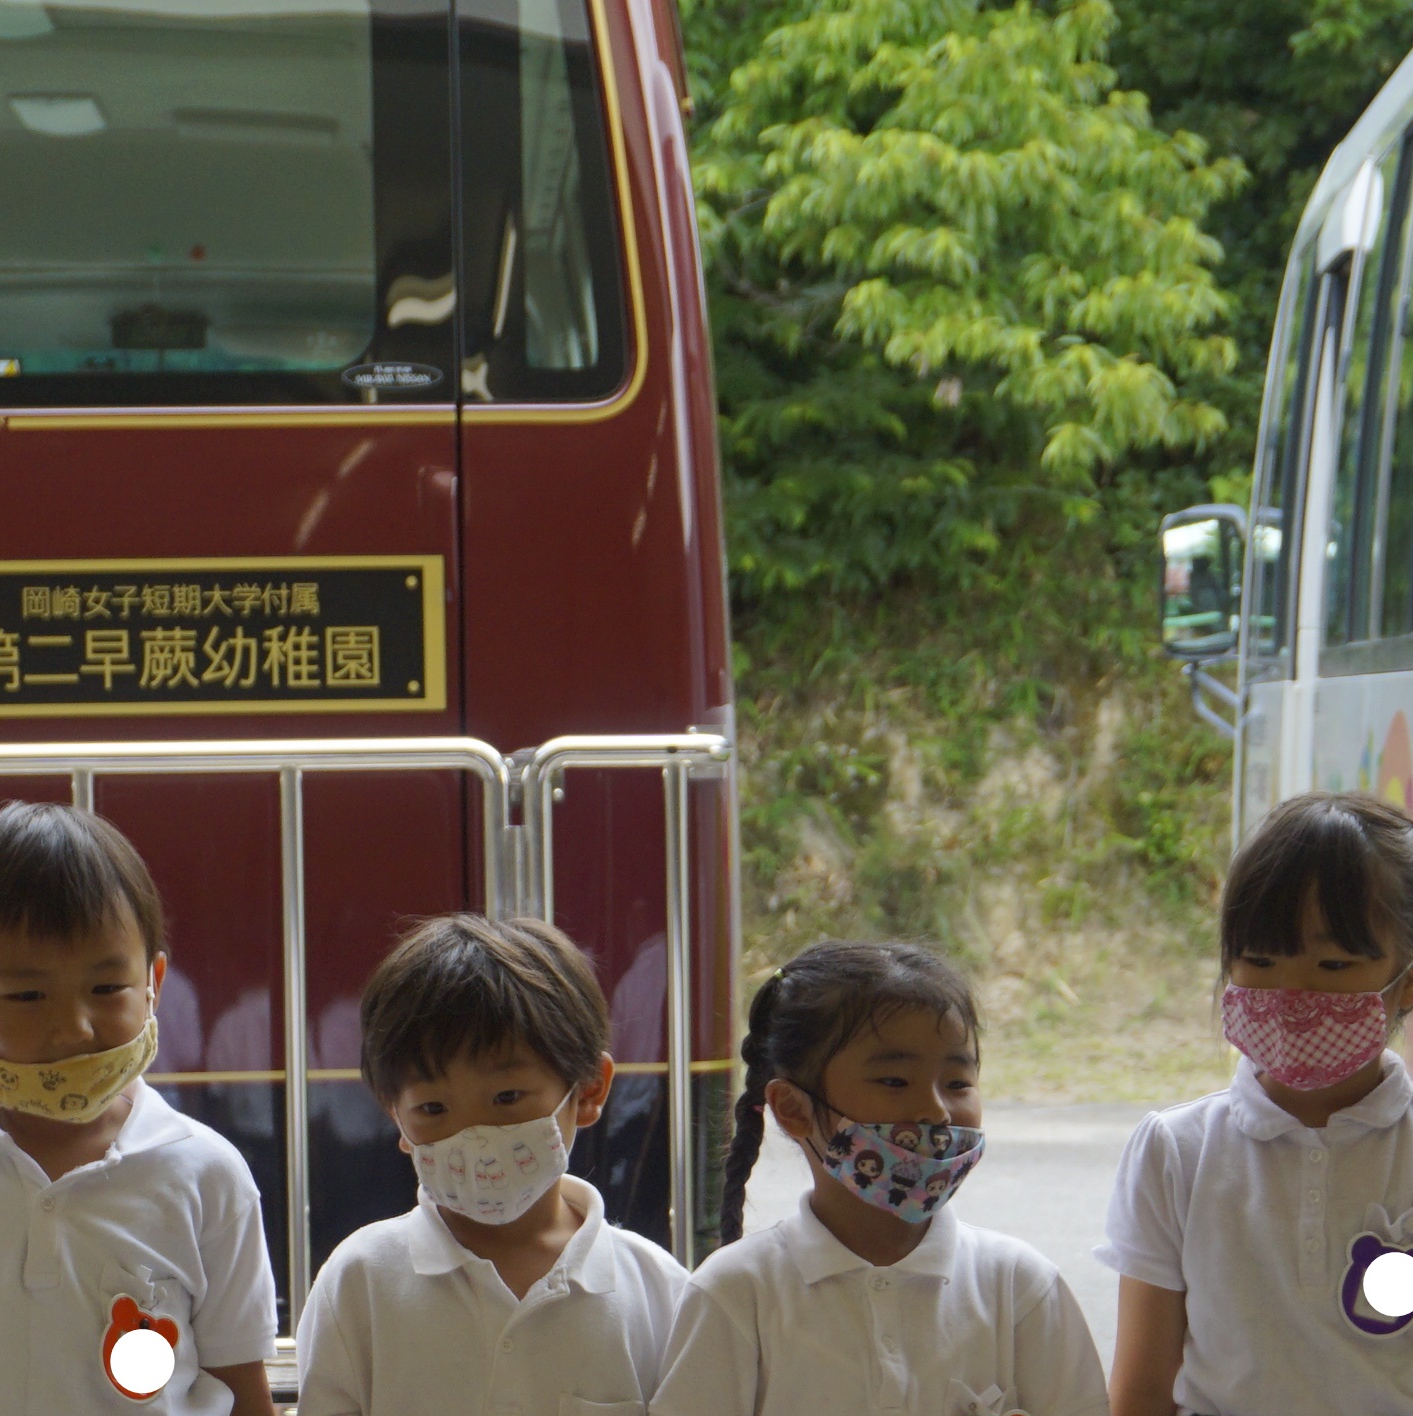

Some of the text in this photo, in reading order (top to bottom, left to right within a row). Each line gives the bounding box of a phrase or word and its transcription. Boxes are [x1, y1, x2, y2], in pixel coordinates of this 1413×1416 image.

[21, 582, 321, 620] 岡崎女子短期大学付属
